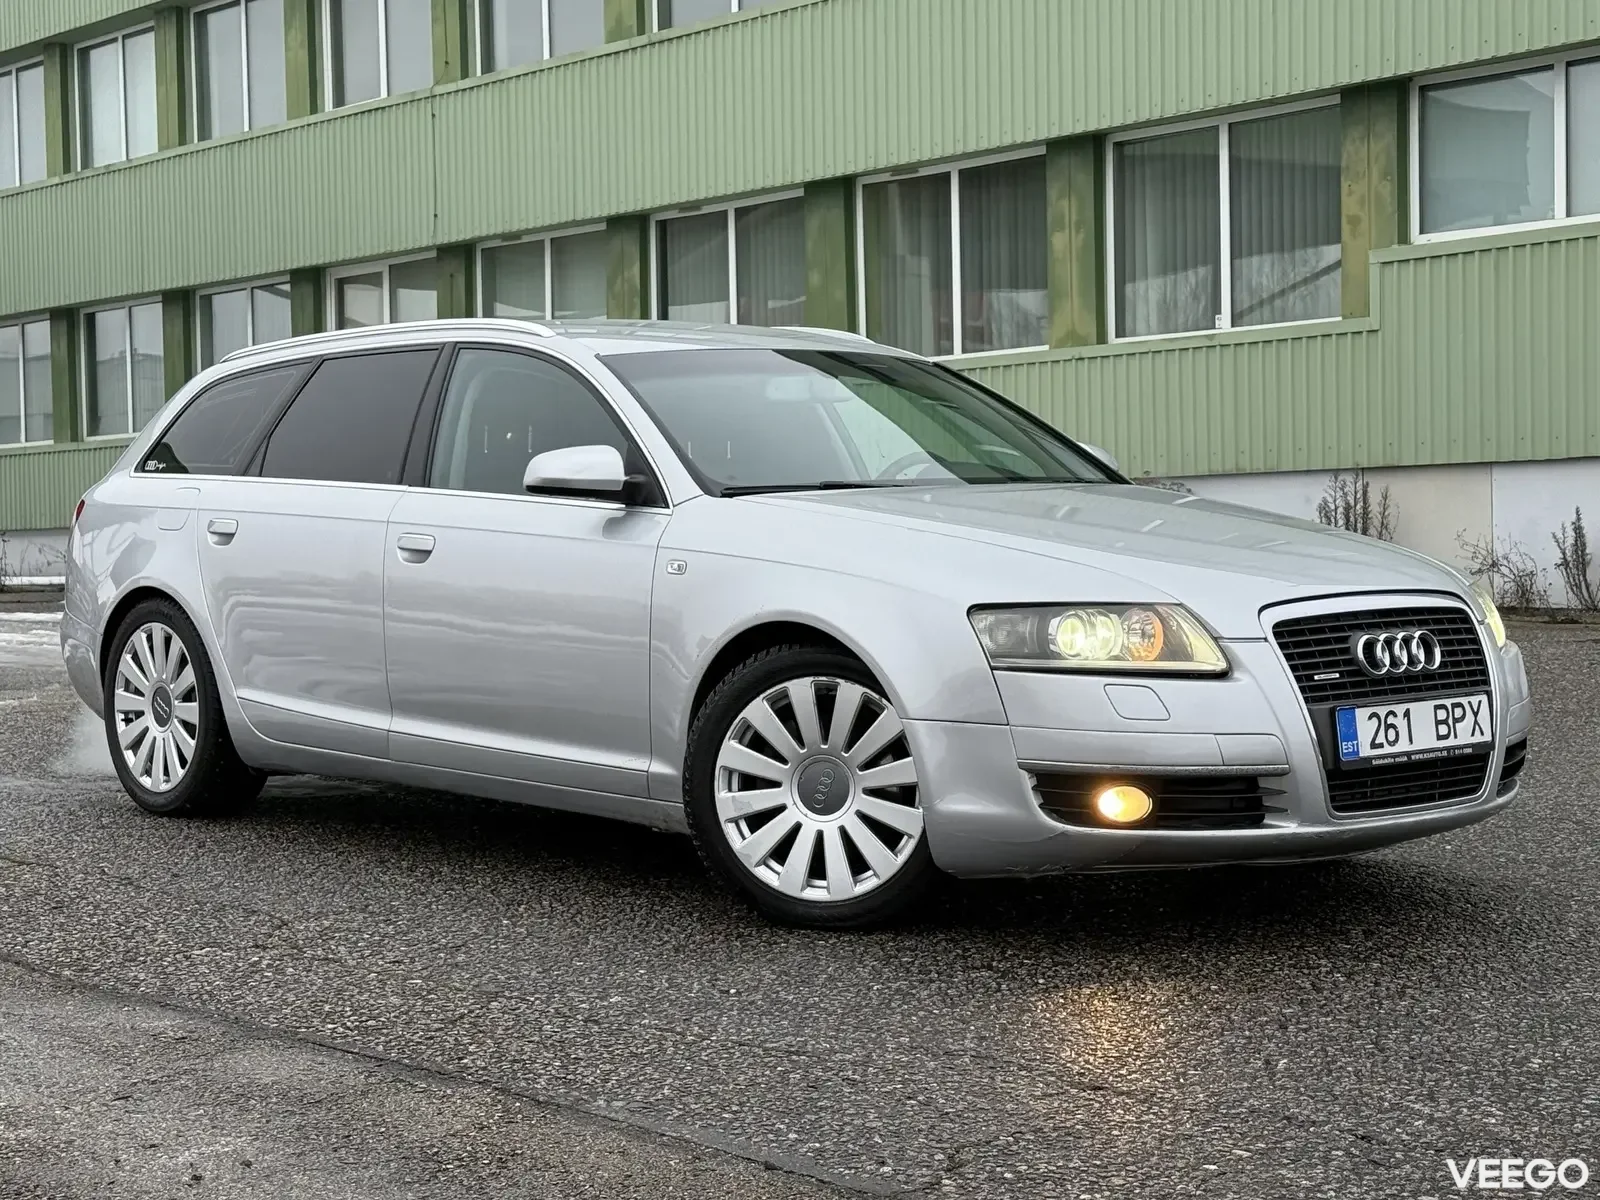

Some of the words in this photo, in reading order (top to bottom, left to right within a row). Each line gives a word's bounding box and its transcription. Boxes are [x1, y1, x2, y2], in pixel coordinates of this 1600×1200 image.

[1367, 708, 1414, 749] 261
[1433, 700, 1485, 741] BPX
[1342, 740, 1358, 753] EST
